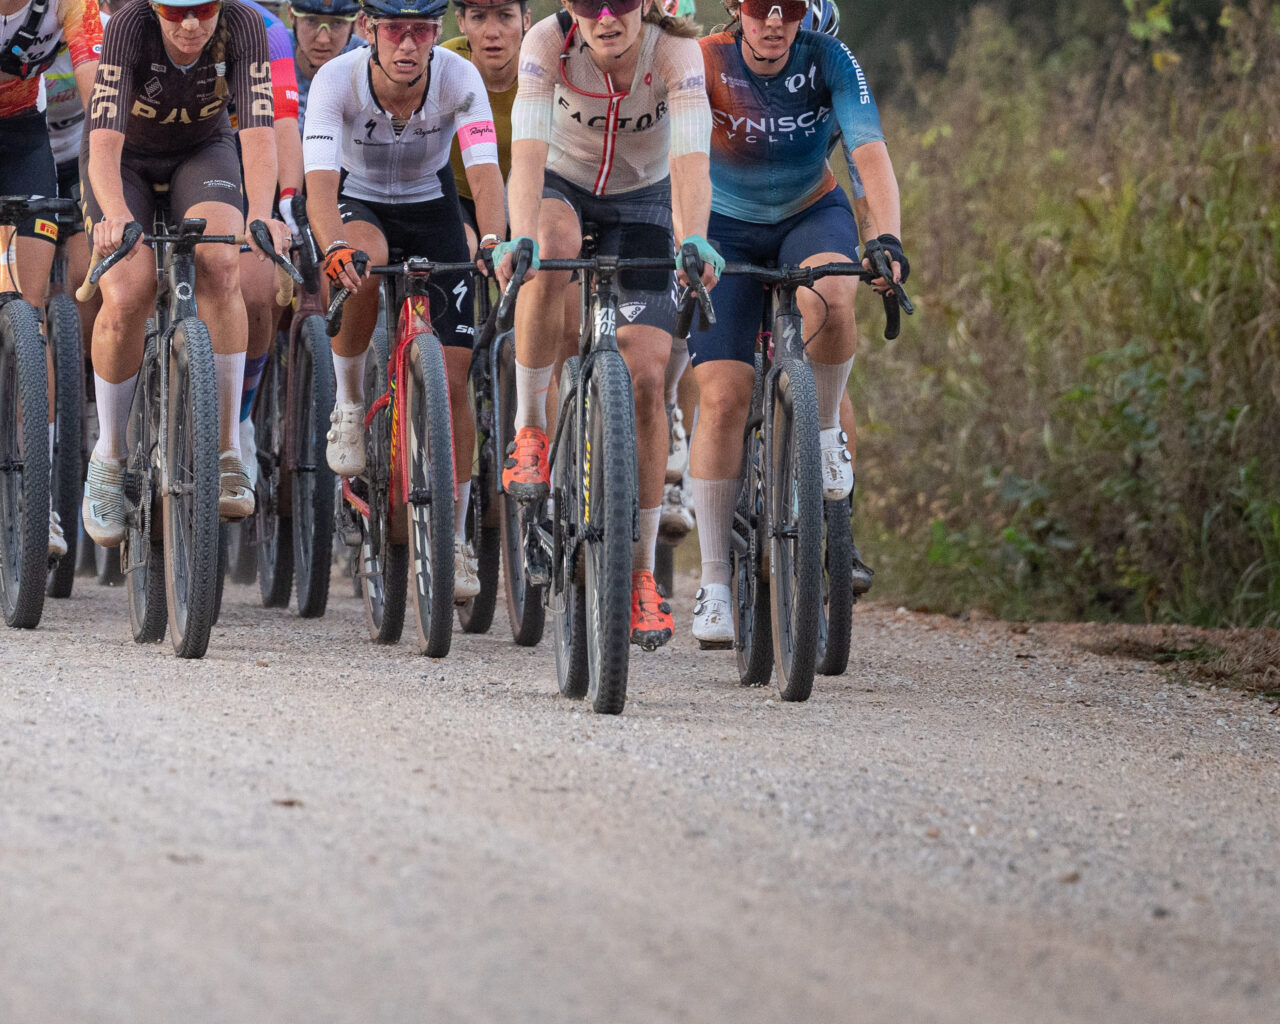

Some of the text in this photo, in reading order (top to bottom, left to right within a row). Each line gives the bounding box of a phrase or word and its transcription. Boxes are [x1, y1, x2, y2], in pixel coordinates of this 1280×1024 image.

[91, 64, 122, 119] PAS
[250, 61, 274, 117] PAS
[840, 42, 870, 104] SHIMANO
[131, 100, 223, 124] PAS
[558, 96, 668, 133] FACTOR
[712, 106, 832, 133] CYNISCA
[470, 126, 493, 136] Rapha
